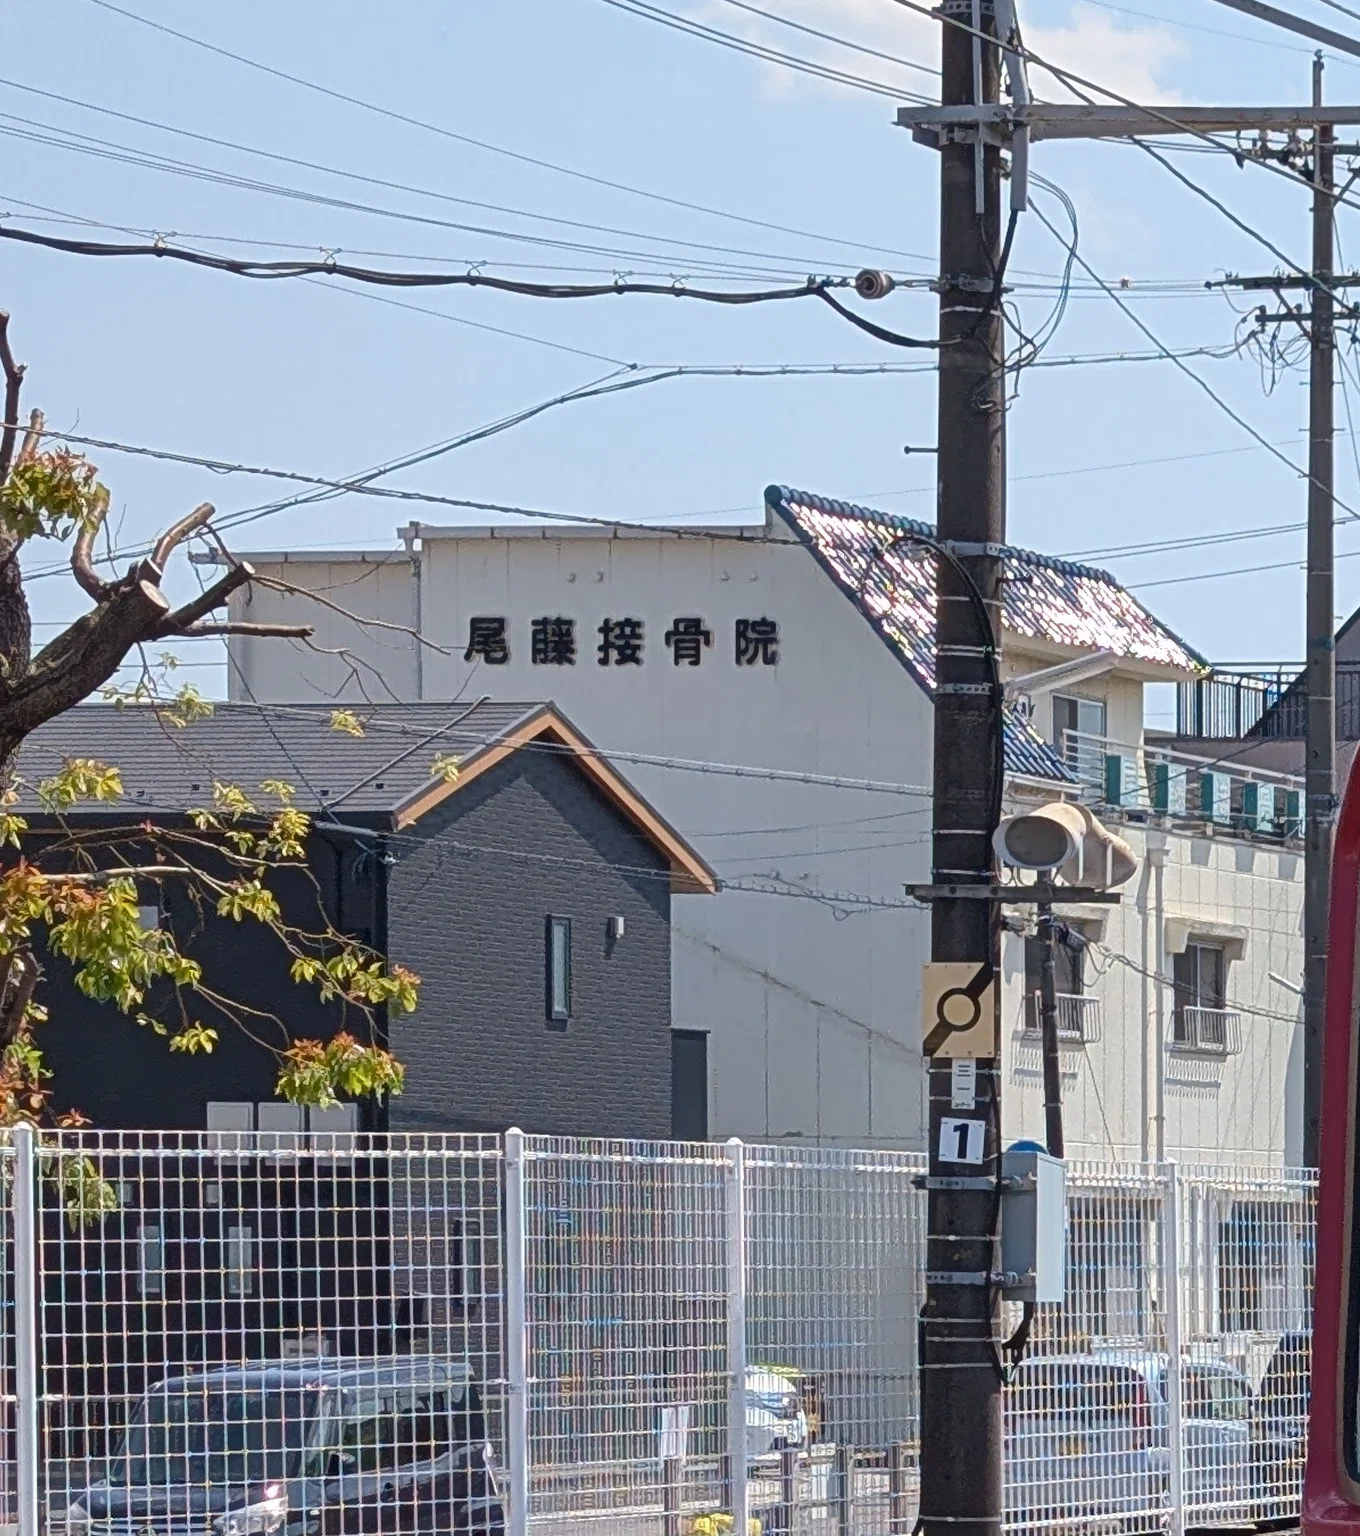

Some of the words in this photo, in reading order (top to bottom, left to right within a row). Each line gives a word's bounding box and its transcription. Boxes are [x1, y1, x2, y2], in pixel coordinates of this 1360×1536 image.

[463, 616, 780, 667] 尾藤接骨院
[953, 1122, 970, 1160] 1
